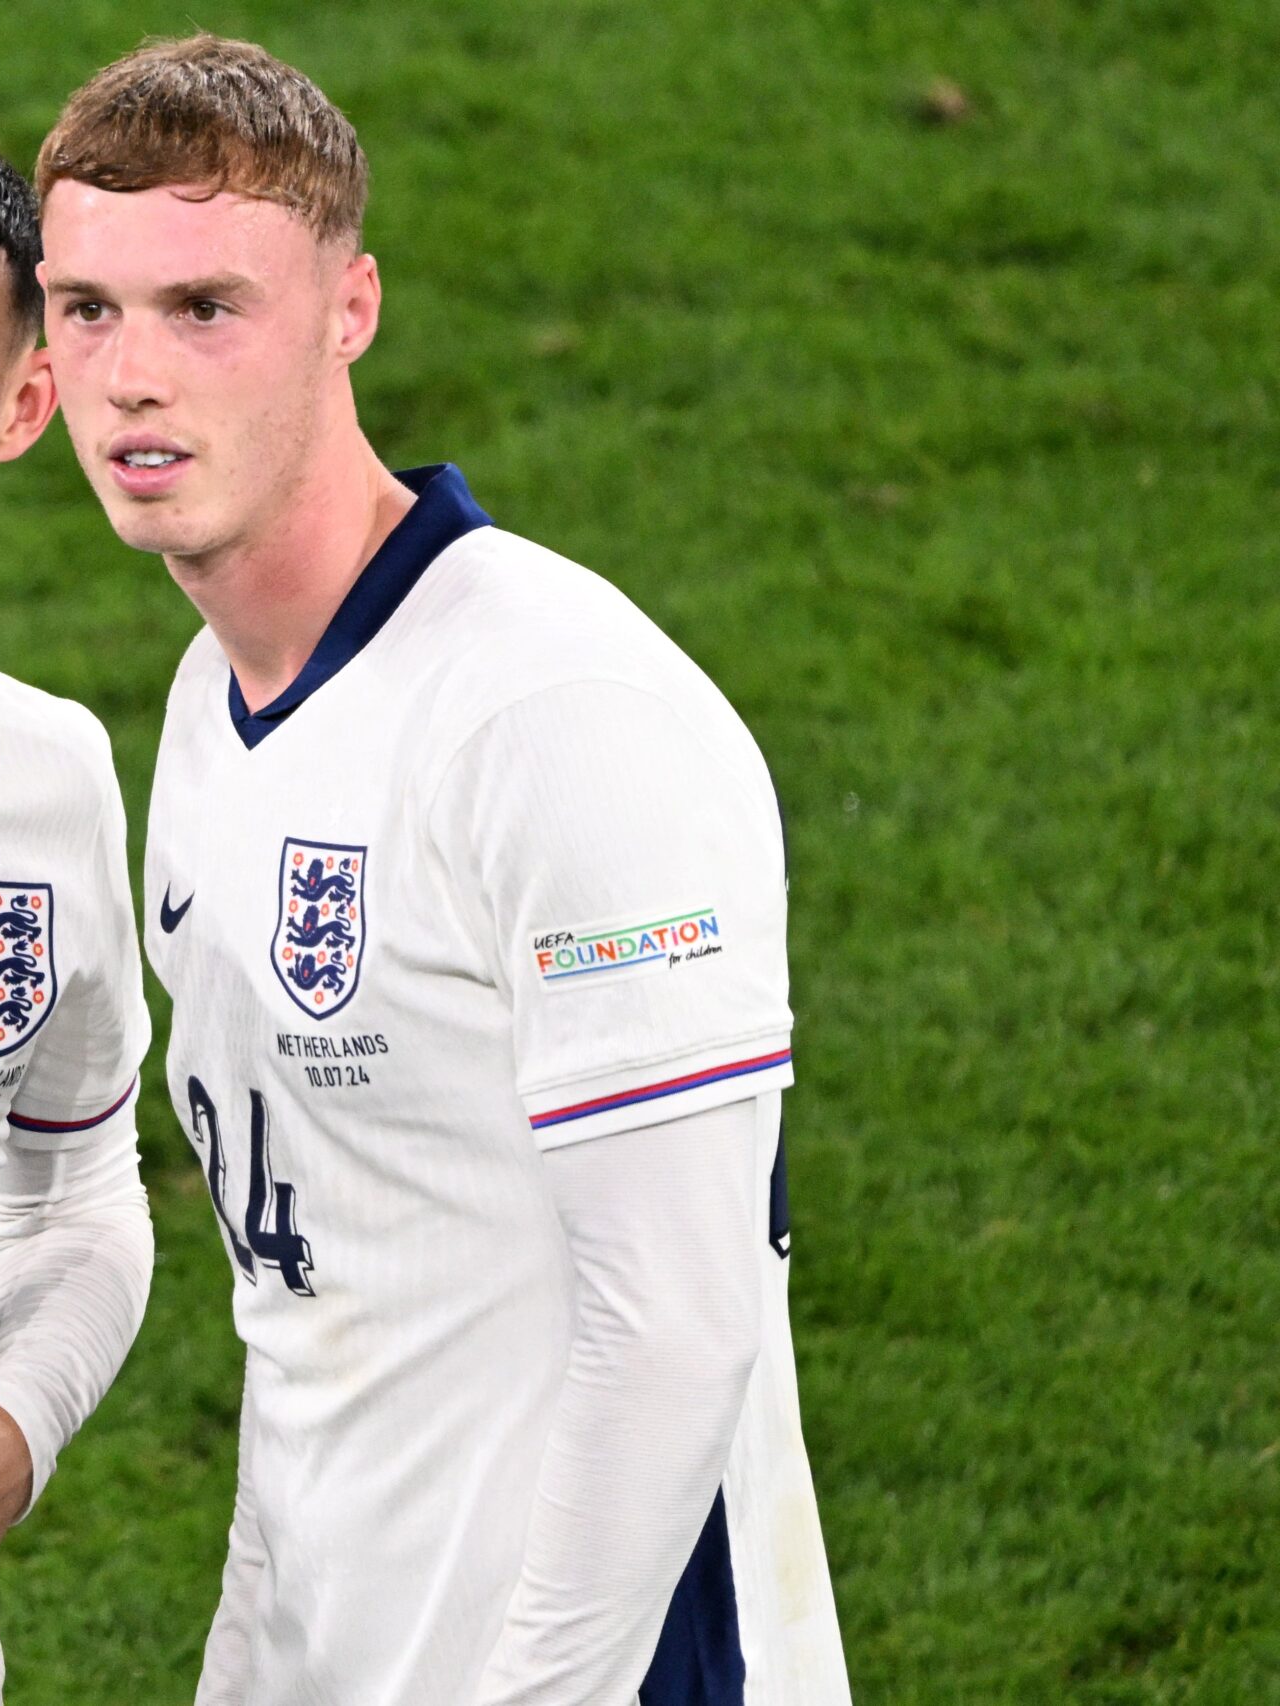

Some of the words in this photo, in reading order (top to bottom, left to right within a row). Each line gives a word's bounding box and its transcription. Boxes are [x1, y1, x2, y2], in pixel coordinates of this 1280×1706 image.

[533, 931, 575, 950] UEFA
[669, 952, 682, 969] for
[685, 944, 722, 961] children
[276, 1033, 389, 1058] NETHERLANDS
[304, 1065, 370, 1088] 10.07.24
[187, 1075, 317, 1297] 24
